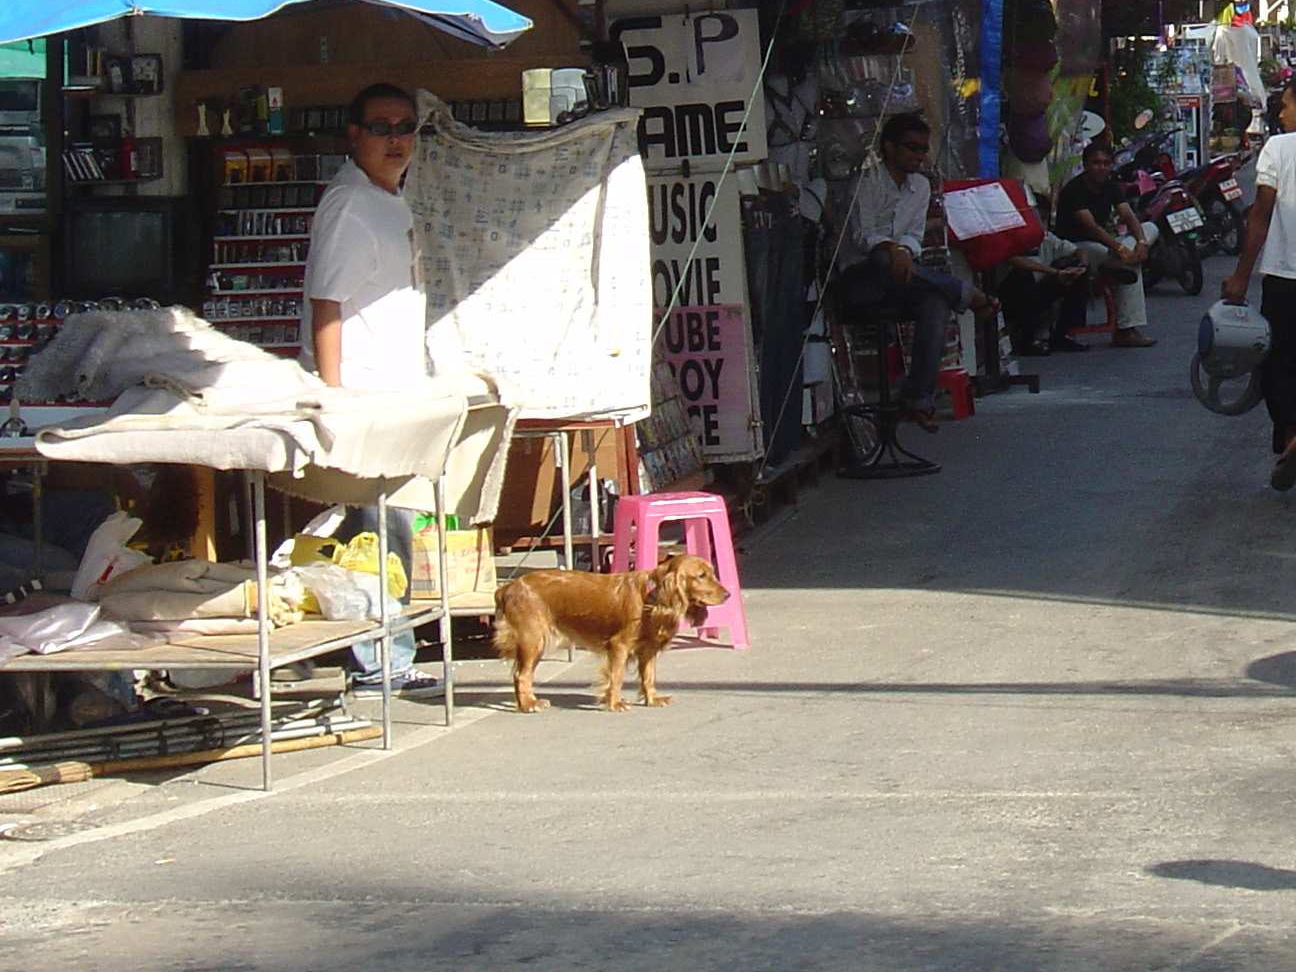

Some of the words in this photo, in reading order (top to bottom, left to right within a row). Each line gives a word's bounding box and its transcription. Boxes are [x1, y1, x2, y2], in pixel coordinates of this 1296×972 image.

[640, 100, 748, 159] AME
[650, 181, 717, 245] USIC
[652, 257, 721, 307] OVIE
[663, 311, 721, 354] UBE
